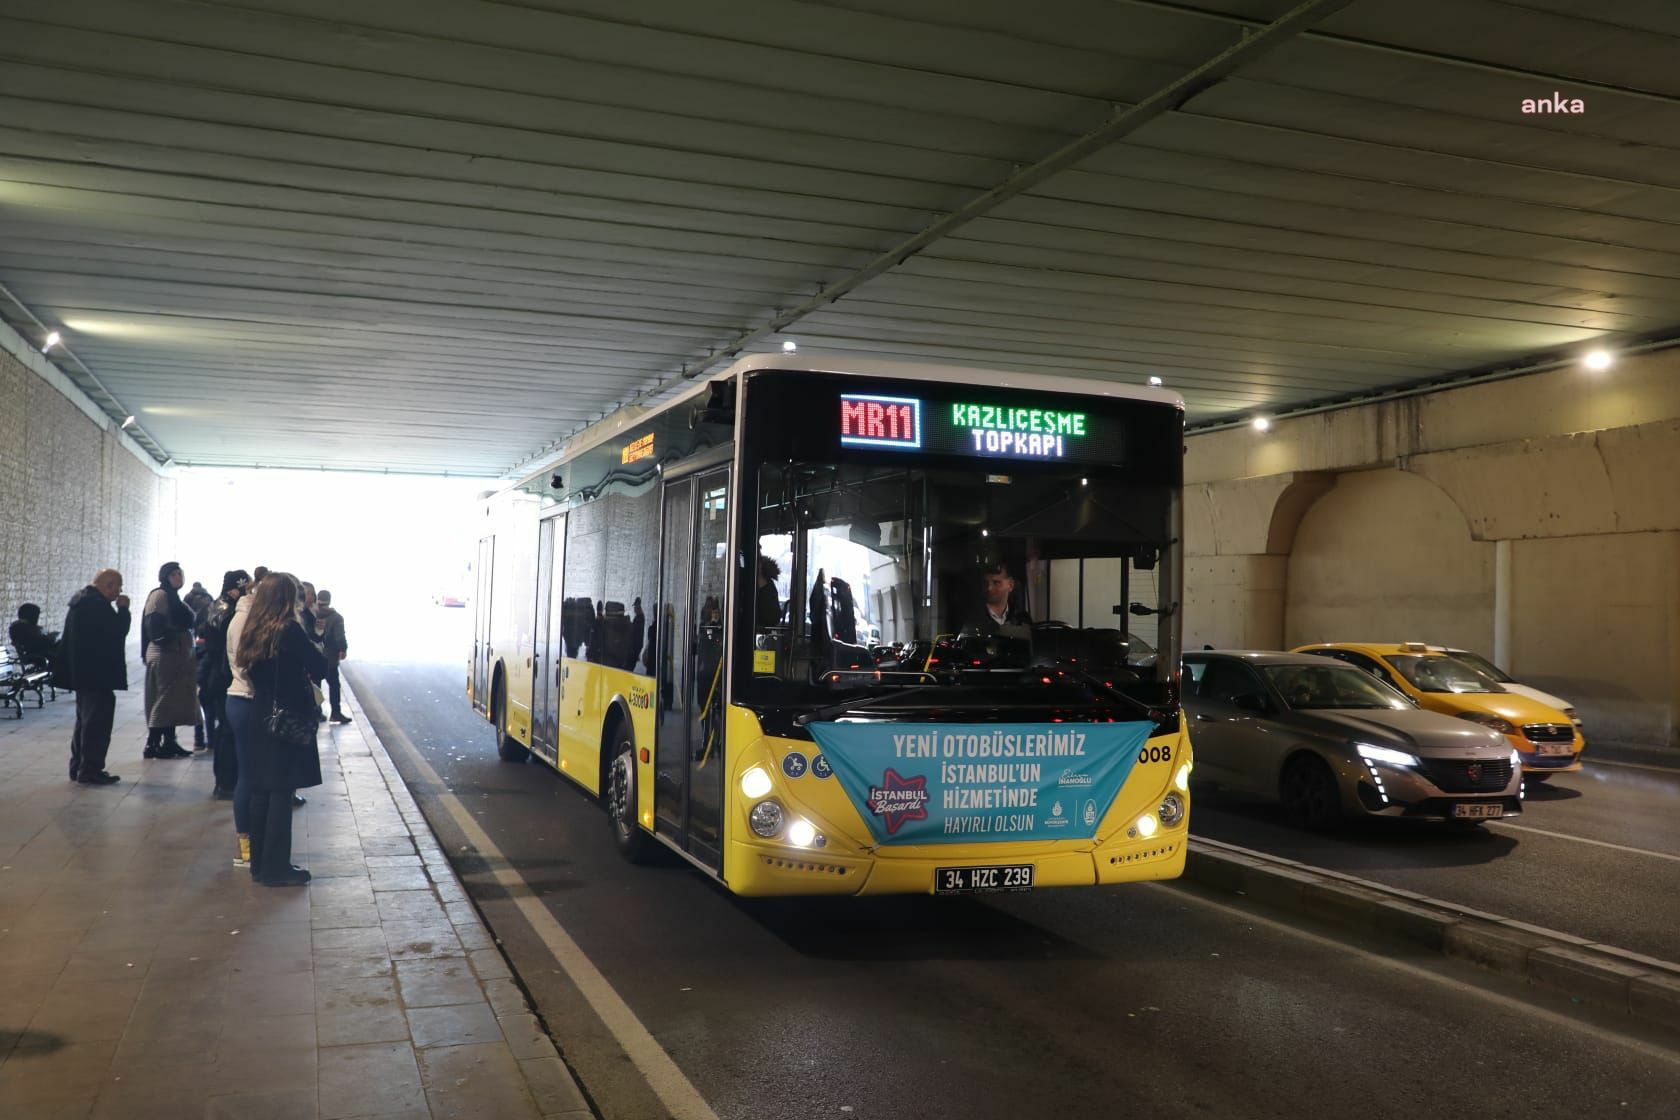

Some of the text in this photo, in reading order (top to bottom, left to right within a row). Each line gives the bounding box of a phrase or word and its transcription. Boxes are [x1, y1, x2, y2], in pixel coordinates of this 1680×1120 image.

[841, 400, 912, 440] MR11
[972, 429, 1063, 456] TOPKAPI
[893, 730, 1086, 758] YENİ OTOBÜSLERİMİZ
[941, 761, 1041, 784] İSTANBUL'UN
[871, 788, 928, 800] İSTANBUL
[943, 785, 1039, 809] HİZMETİNDE
[944, 816, 992, 834] HAYIRLI
[994, 814, 1034, 832] OLSUN
[945, 867, 1030, 889] 34 HZC 239
